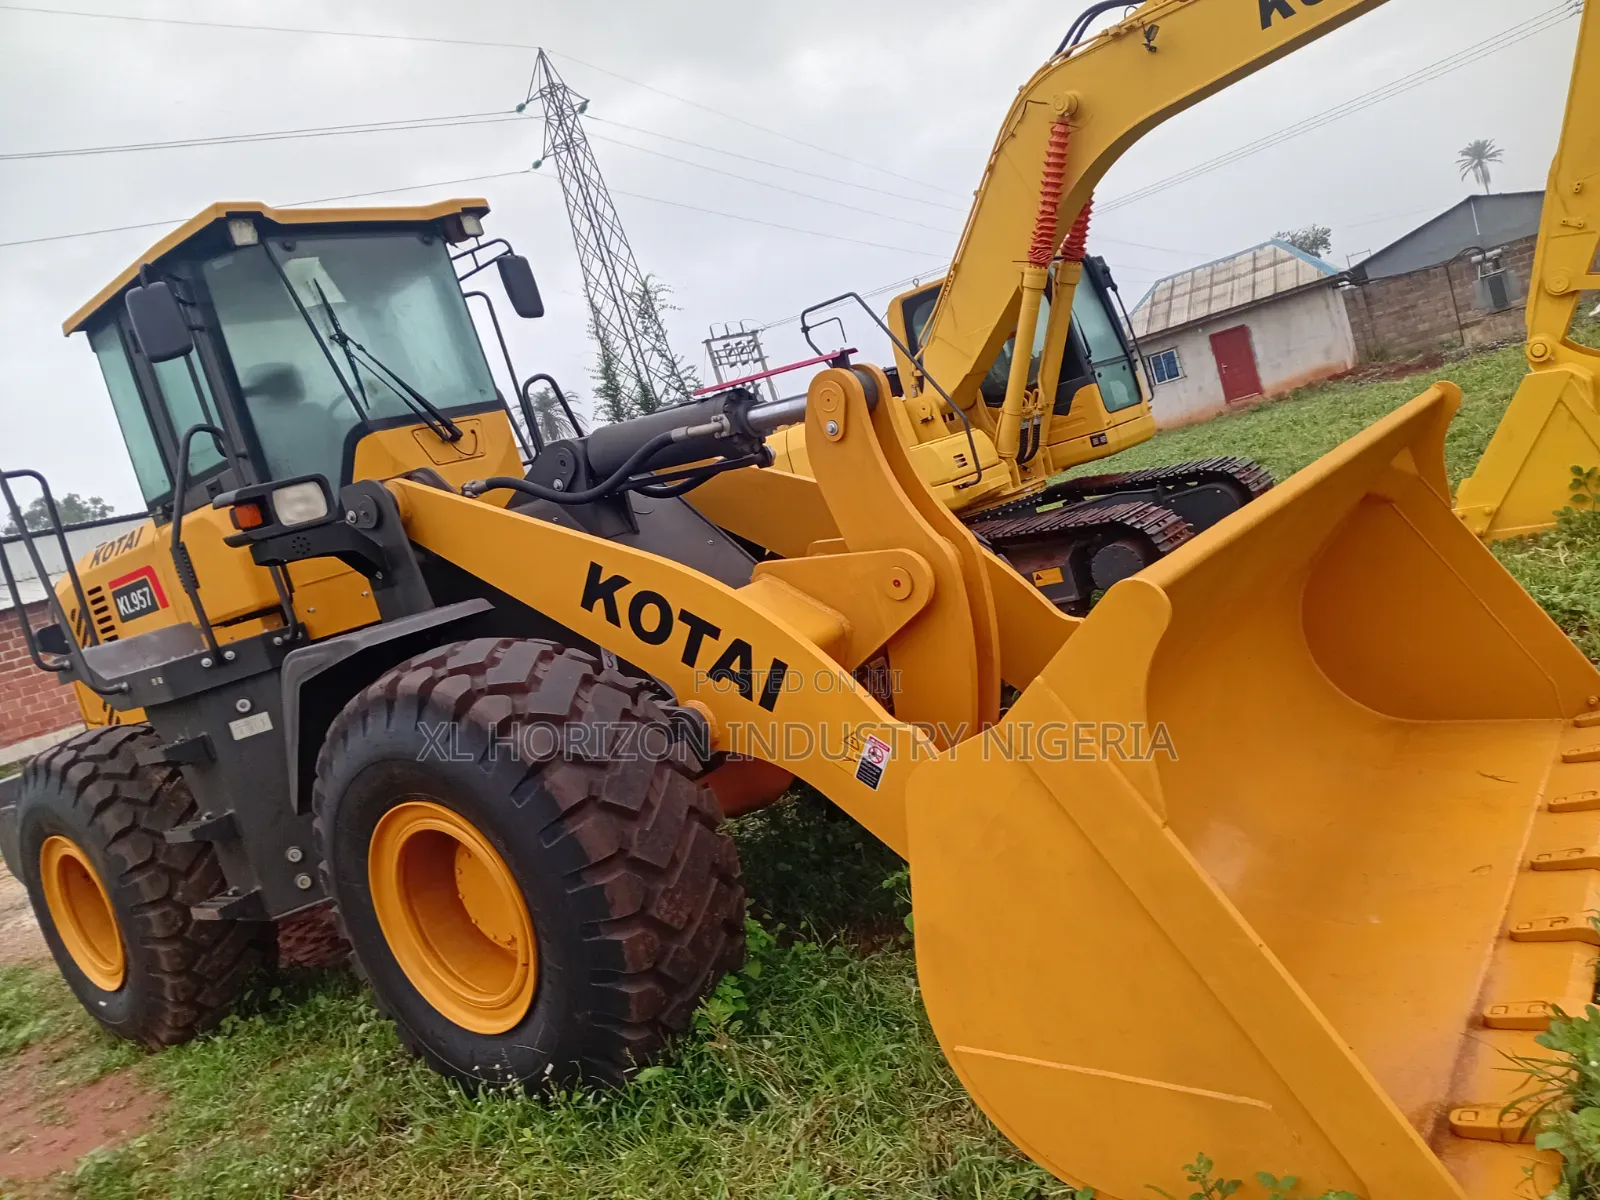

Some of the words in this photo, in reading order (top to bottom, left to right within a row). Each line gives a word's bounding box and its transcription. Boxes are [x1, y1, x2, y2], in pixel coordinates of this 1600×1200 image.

[89, 526, 144, 569] KOTAI
[116, 587, 152, 616] KL957
[580, 560, 788, 713] KOTAI
